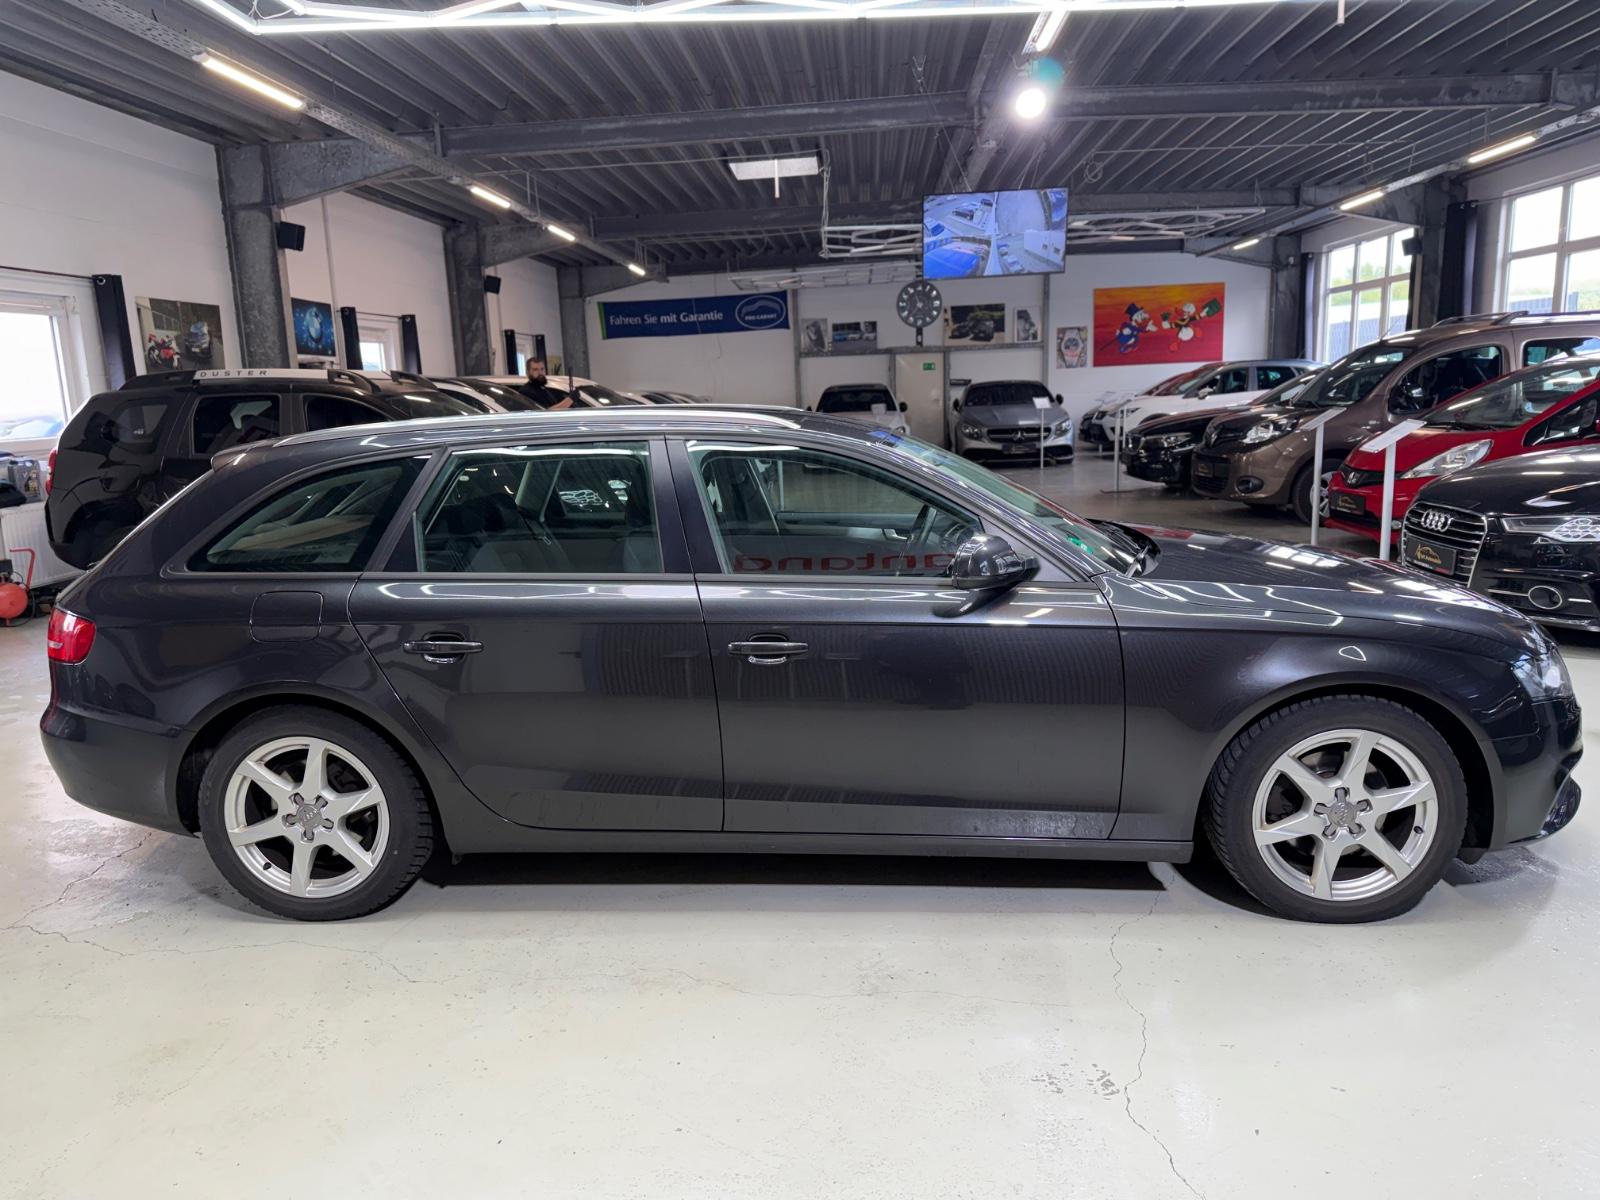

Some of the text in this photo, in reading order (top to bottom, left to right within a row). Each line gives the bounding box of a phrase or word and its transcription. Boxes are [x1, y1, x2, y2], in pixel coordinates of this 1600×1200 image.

[609, 310, 724, 325] Fahren Sie mit Garantie
[200, 370, 268, 378] DUSTER
